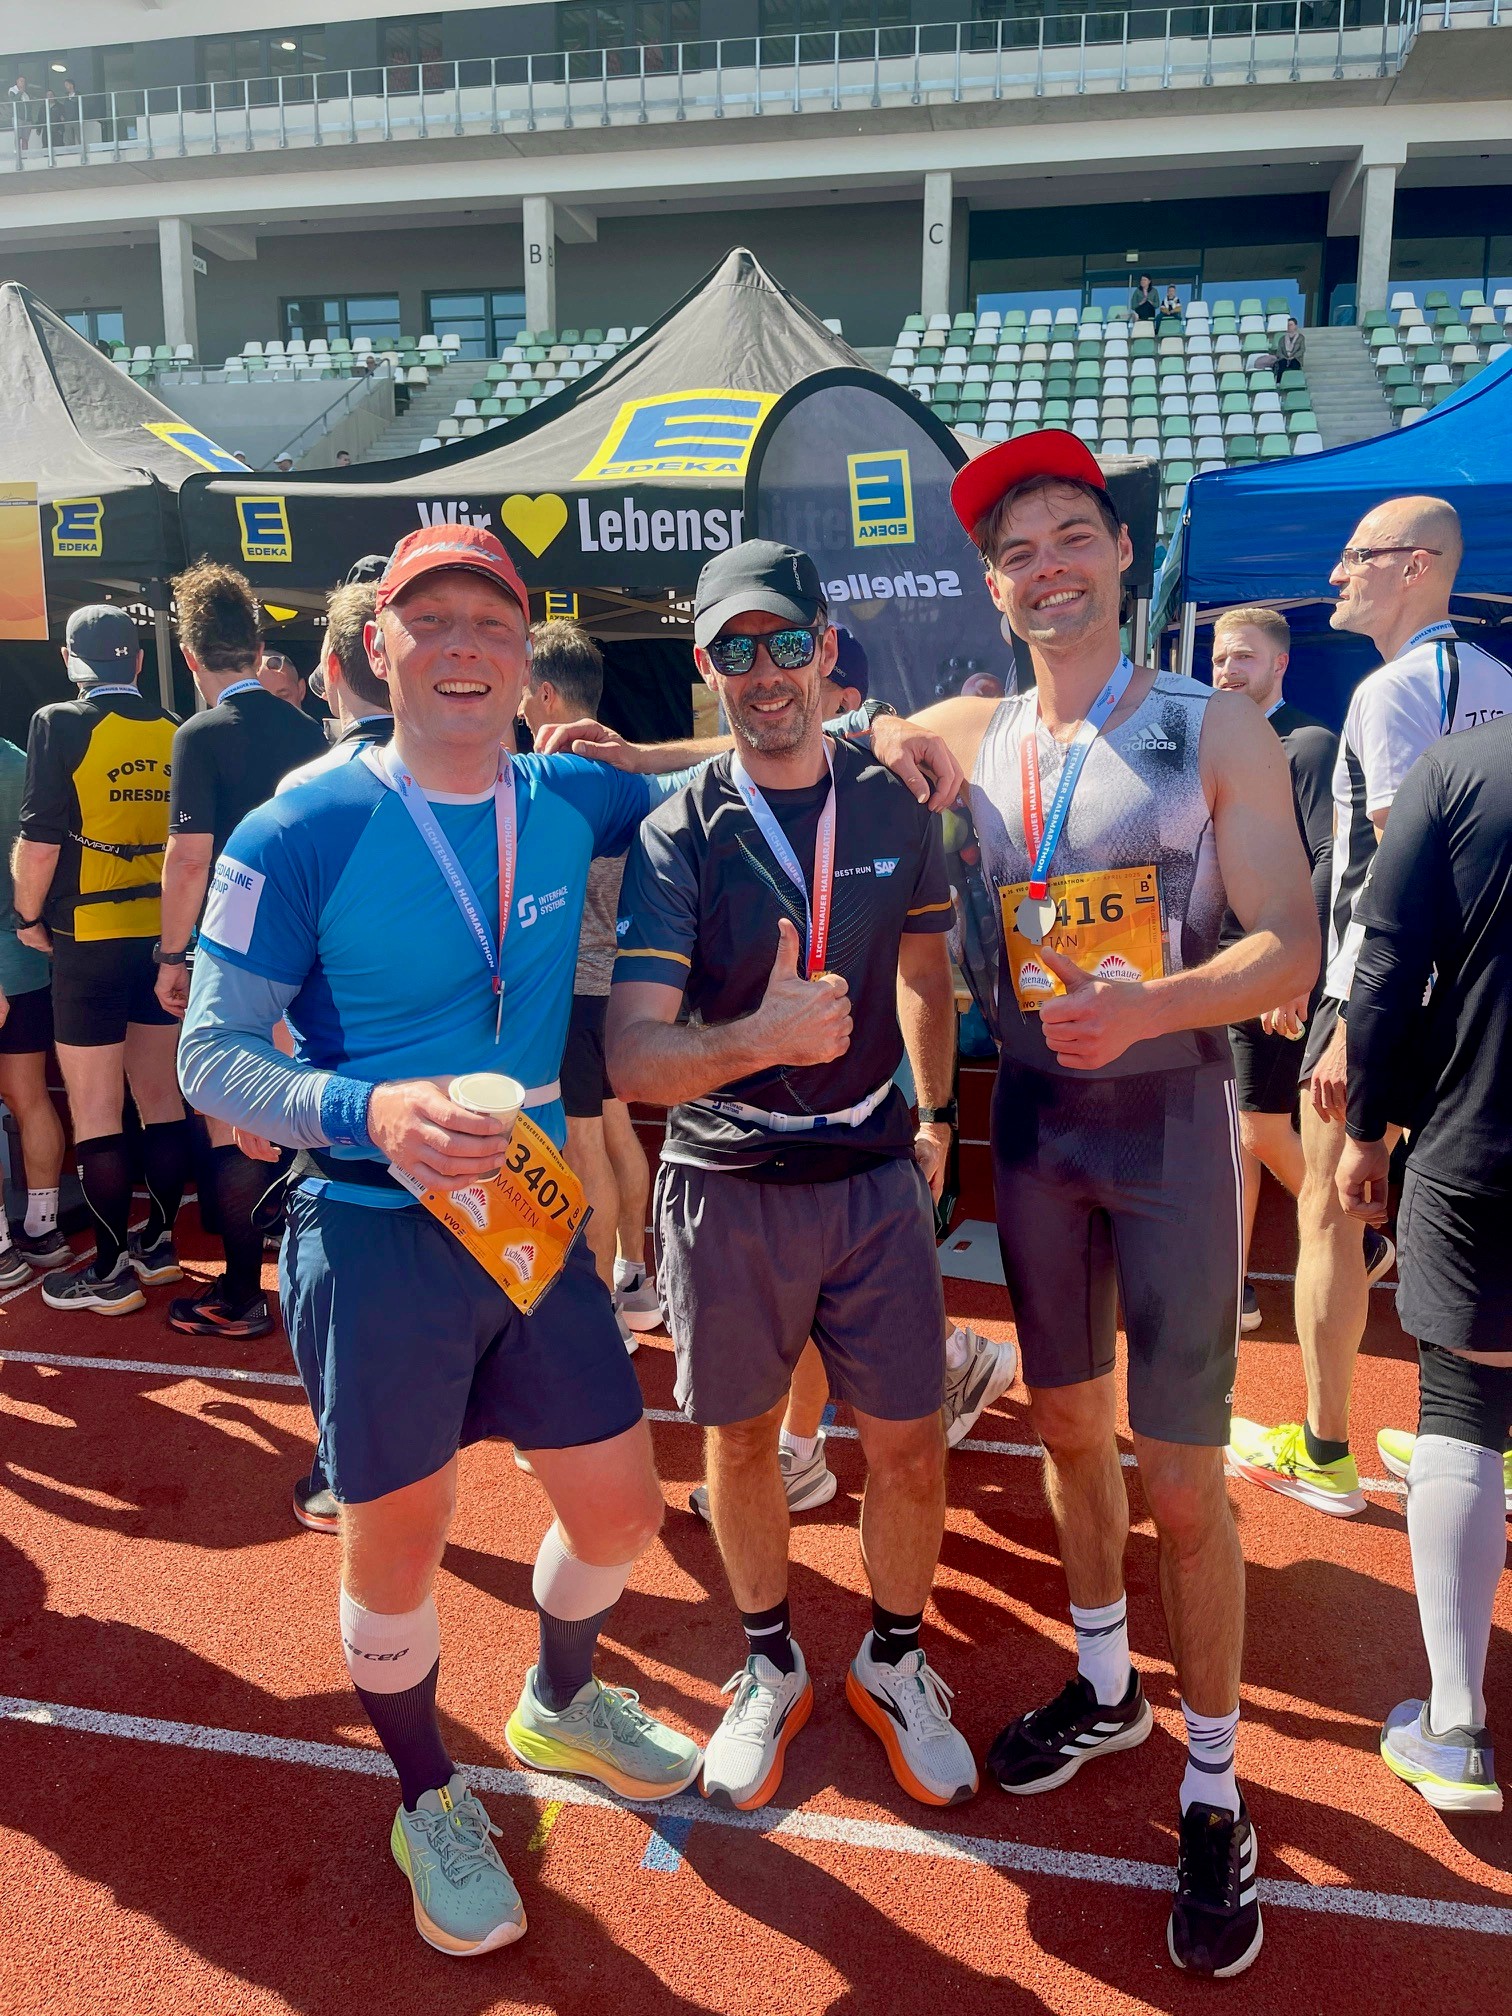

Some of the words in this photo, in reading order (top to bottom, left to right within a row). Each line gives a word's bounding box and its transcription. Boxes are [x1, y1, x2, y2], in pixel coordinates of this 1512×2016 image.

[929, 222, 943, 244] C
[530, 243, 542, 263] B
[596, 461, 739, 476] EDEKA
[58, 543, 98, 552] EDEKA
[246, 547, 288, 557] EDEKA
[1120, 738, 1178, 752] adidas
[107, 759, 158, 783] POST
[1026, 740, 1038, 811] HALBMARATHON
[68, 829, 120, 854] HAMPION
[1036, 796, 1065, 873] HALBMARATHON
[503, 816, 512, 900] HALBMARATHON
[766, 826, 801, 883] LICHTENAUER
[820, 815, 831, 893] HALBMARATHON
[834, 868, 854, 878] BEST
[855, 865, 872, 875] RUN
[874, 861, 896, 874] SAP
[422, 821, 460, 890] LICHTENAUER
[457, 887, 495, 969] HALBMARATHON
[538, 885, 569, 905] INTERFACE
[1140, 880, 1150, 892] B
[540, 898, 566, 915] SYSTEMS
[815, 894, 828, 959] LICHTENAUER
[506, 1135, 570, 1220] 3407
[492, 1173, 540, 1228] MARTIN
[443, 1212, 460, 1231] VVO
[504, 1246, 532, 1282] Lichtenauer
[364, 1648, 410, 1661] cep
